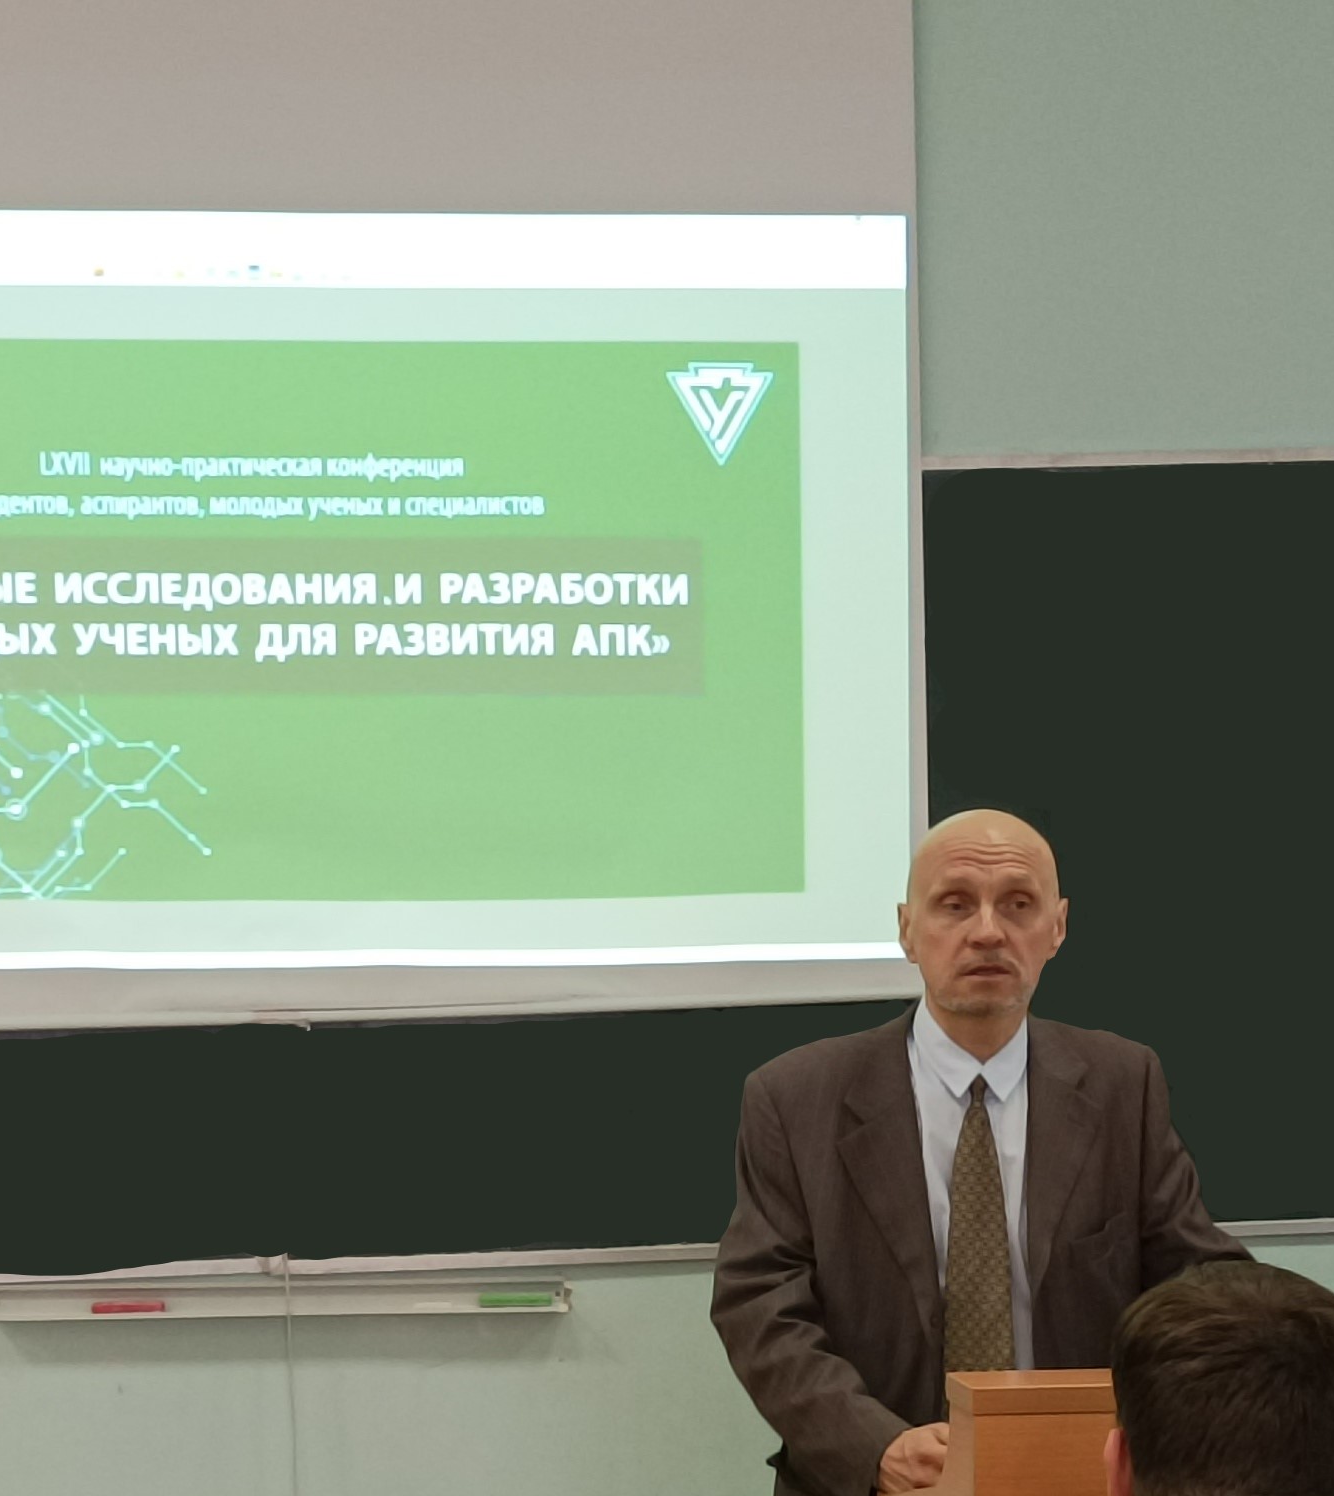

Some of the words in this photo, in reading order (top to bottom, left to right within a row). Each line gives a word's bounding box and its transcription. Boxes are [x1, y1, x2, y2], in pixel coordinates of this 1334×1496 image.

[40, 452, 90, 475] LXVII
[100, 458, 322, 481] научно-практическая
[327, 453, 463, 481] конференция
[81, 496, 204, 519] аспирантов,
[210, 497, 303, 518] молодых
[308, 497, 383, 520] ученых
[388, 498, 400, 515] и
[405, 496, 544, 518] специалистов
[395, 574, 421, 604] И
[440, 573, 688, 605] РАЗРАБОТКИ
[73, 623, 238, 655] УЧЕНЫХ
[255, 624, 336, 662] ДЛЯ
[355, 623, 553, 655] РАЗВИТИЯ
[572, 624, 669, 656] АПК»
